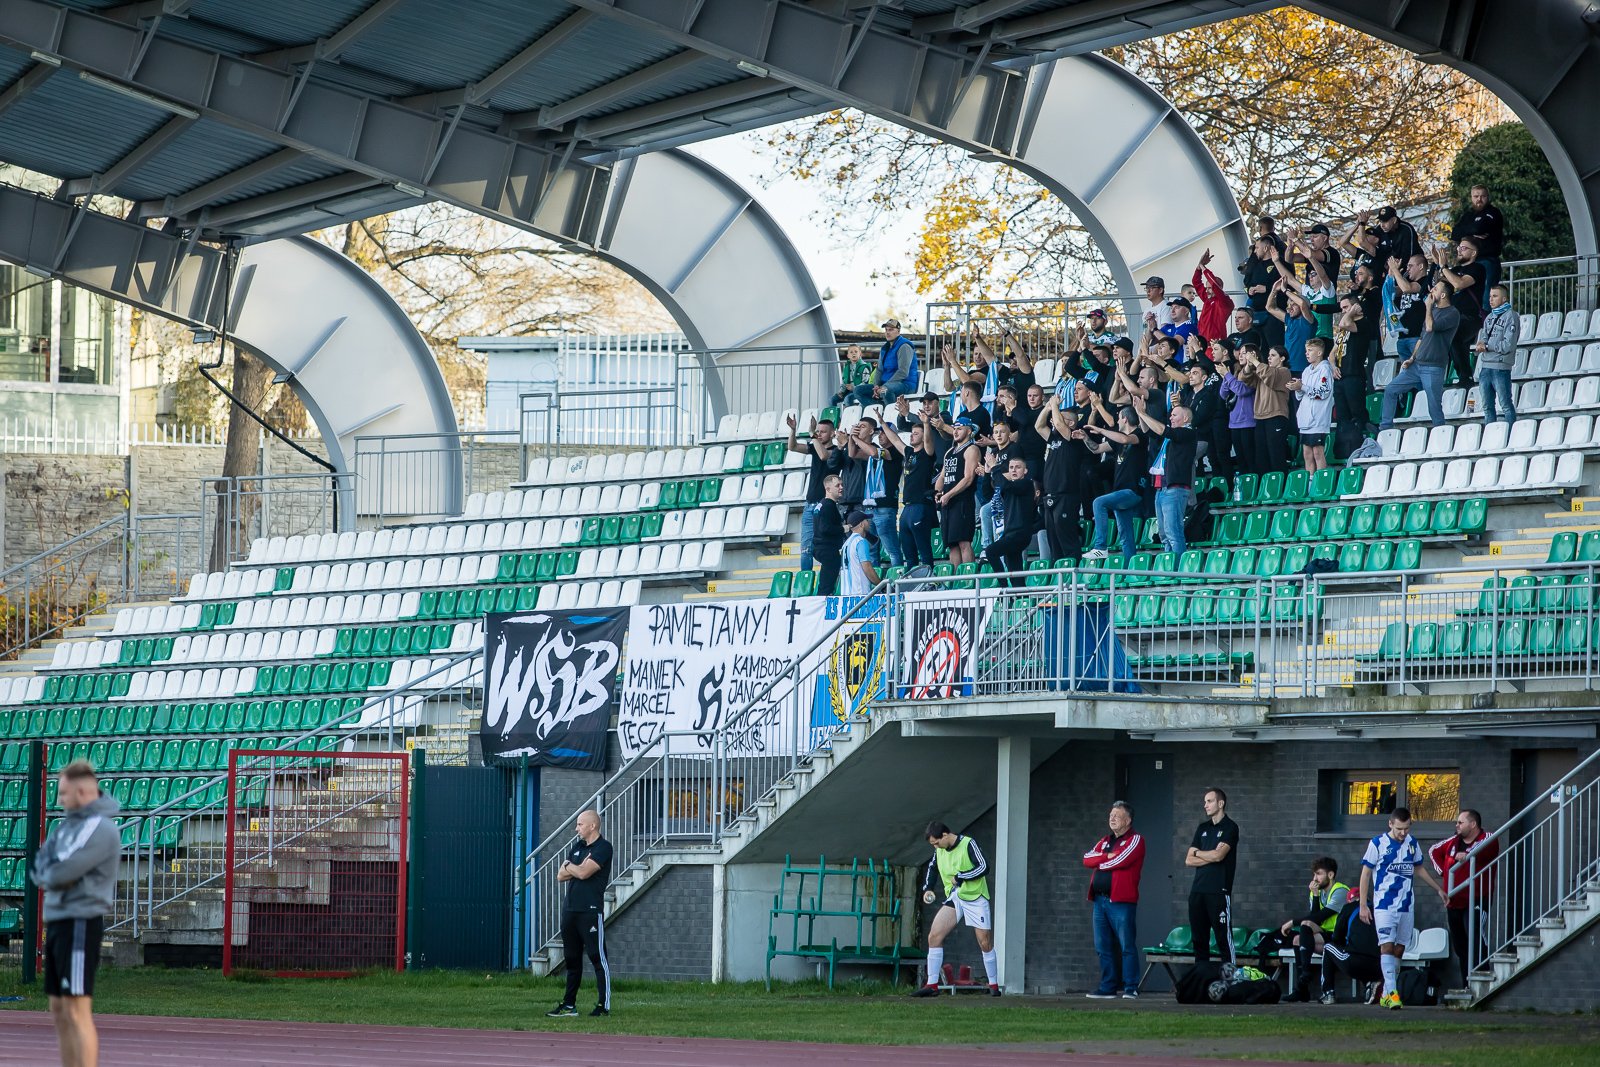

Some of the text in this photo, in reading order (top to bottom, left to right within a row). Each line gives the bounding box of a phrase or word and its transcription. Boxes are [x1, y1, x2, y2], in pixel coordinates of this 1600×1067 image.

[1574, 503, 1582, 511] E5
[1492, 547, 1499, 555] E4
[648, 603, 771, 652] PAMIĘTAMY!
[629, 658, 685, 690] MANIEK
[624, 691, 675, 717] MARCEL
[1219, 916, 1226, 924] 41
